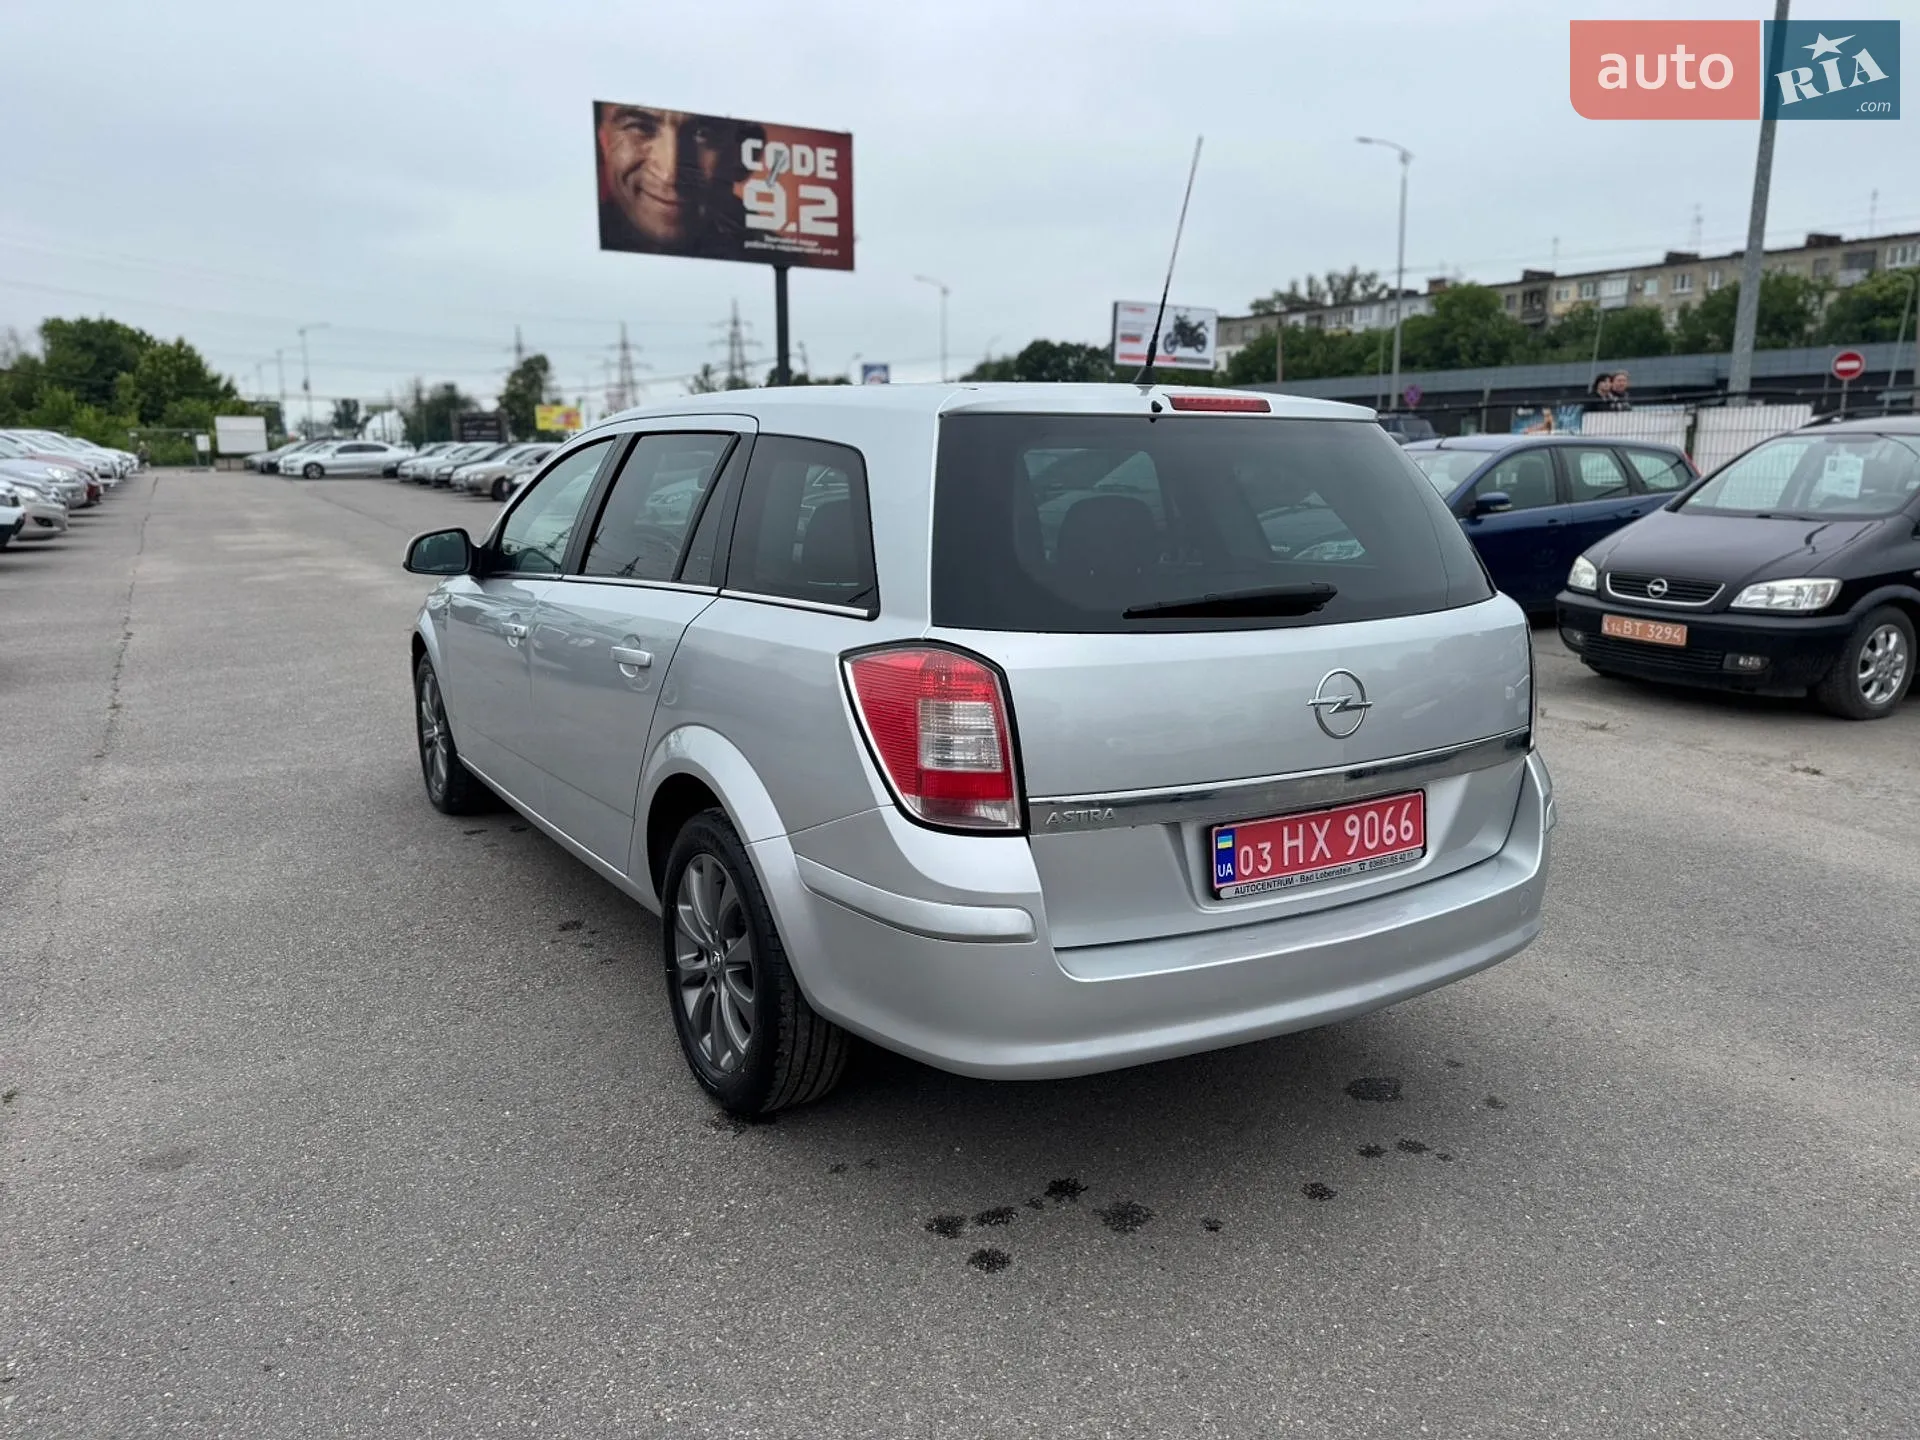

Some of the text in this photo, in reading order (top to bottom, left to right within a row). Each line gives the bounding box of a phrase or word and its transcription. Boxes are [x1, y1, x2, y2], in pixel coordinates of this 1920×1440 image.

[741, 138, 838, 179] CODE
[743, 179, 838, 236] 9.2
[1623, 620, 1642, 636] BT
[1647, 623, 1682, 642] 3294
[1045, 808, 1115, 824] ASTRA
[1239, 802, 1415, 876] 03 HX 9066
[1217, 862, 1234, 877] UA
[1234, 876, 1295, 895] AUTOCENTRUM
[1300, 873, 1314, 883] Bad
